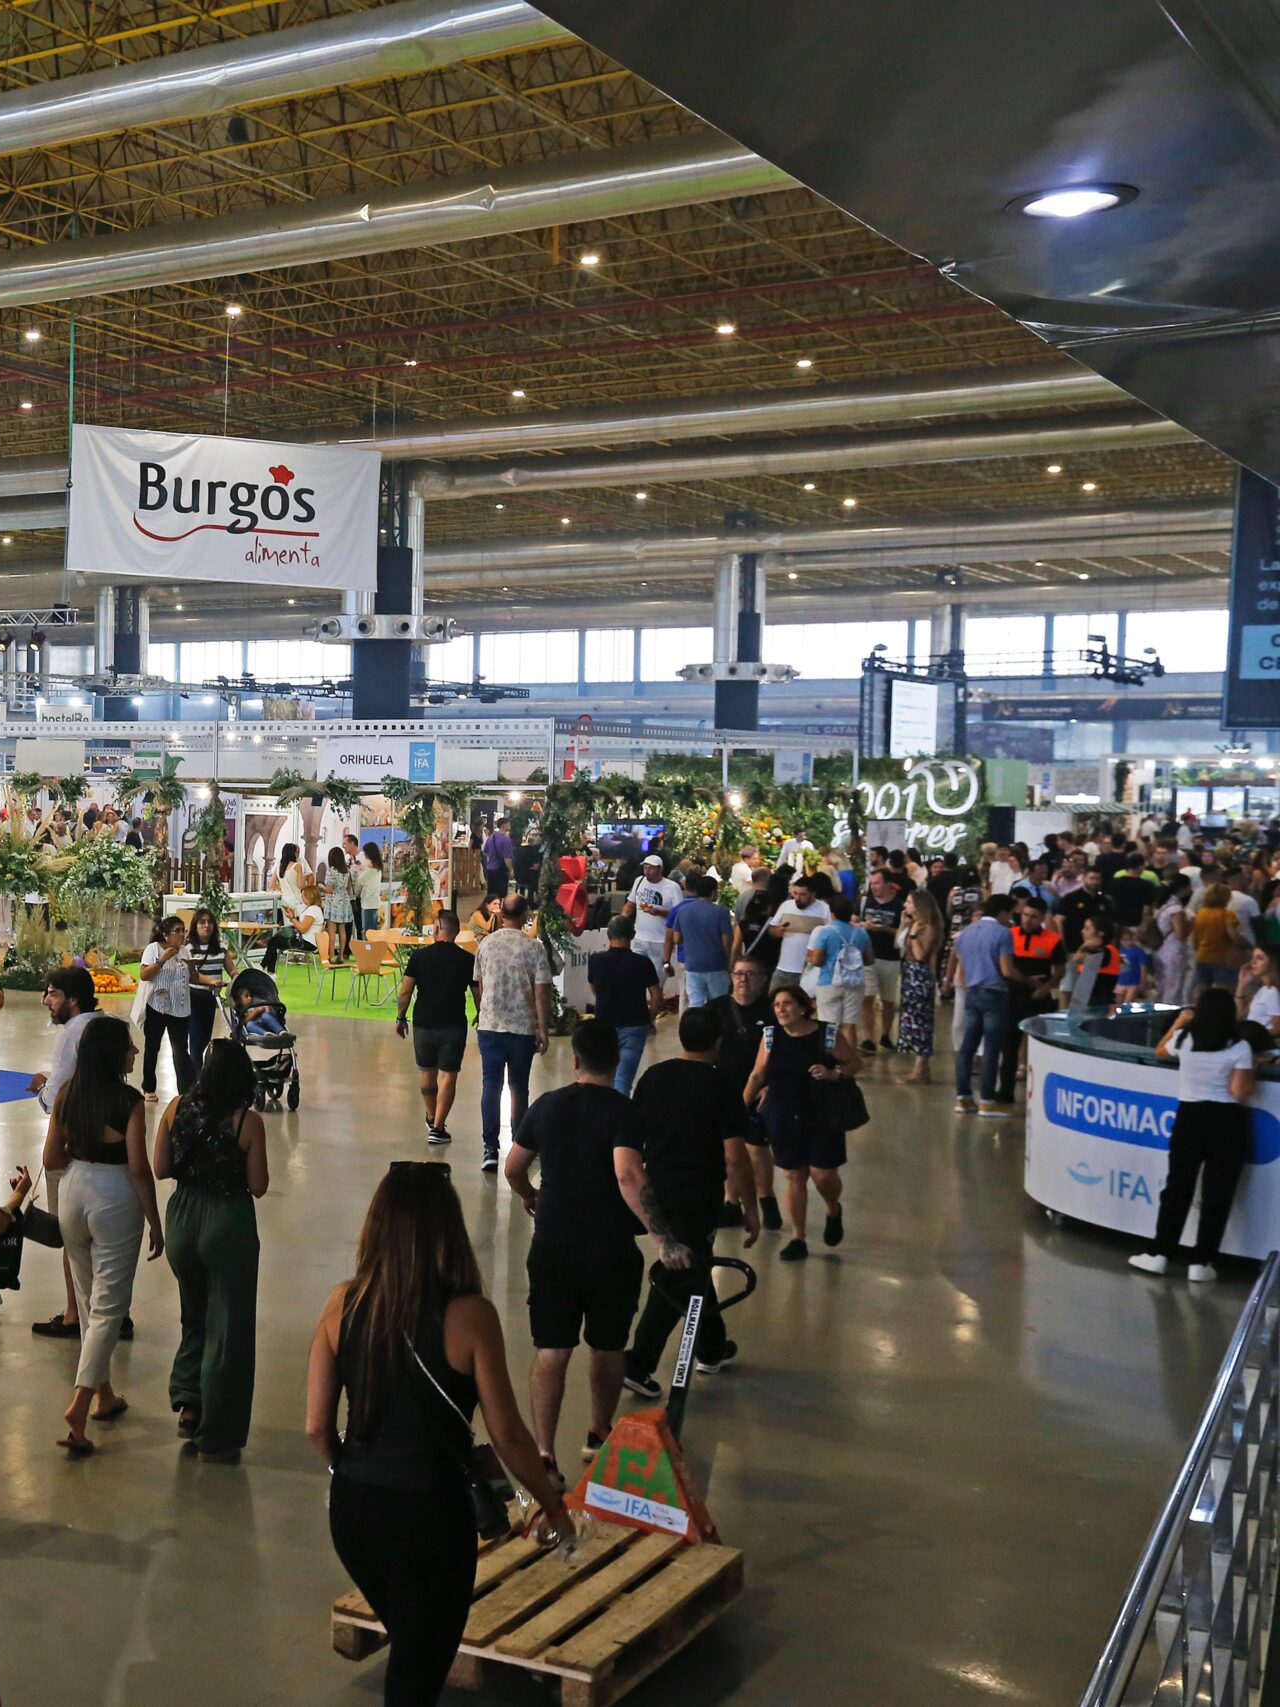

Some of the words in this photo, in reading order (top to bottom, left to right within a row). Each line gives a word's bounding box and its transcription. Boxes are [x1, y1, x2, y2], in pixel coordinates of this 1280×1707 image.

[138, 461, 316, 534] Burgos
[245, 536, 320, 567] alimenta
[339, 754, 394, 765] ORIHUELA
[414, 758, 429, 768] IFA
[1110, 1168, 1153, 1205] IFA
[674, 1363, 685, 1385] VENTA
[624, 1496, 652, 1521] IFA
